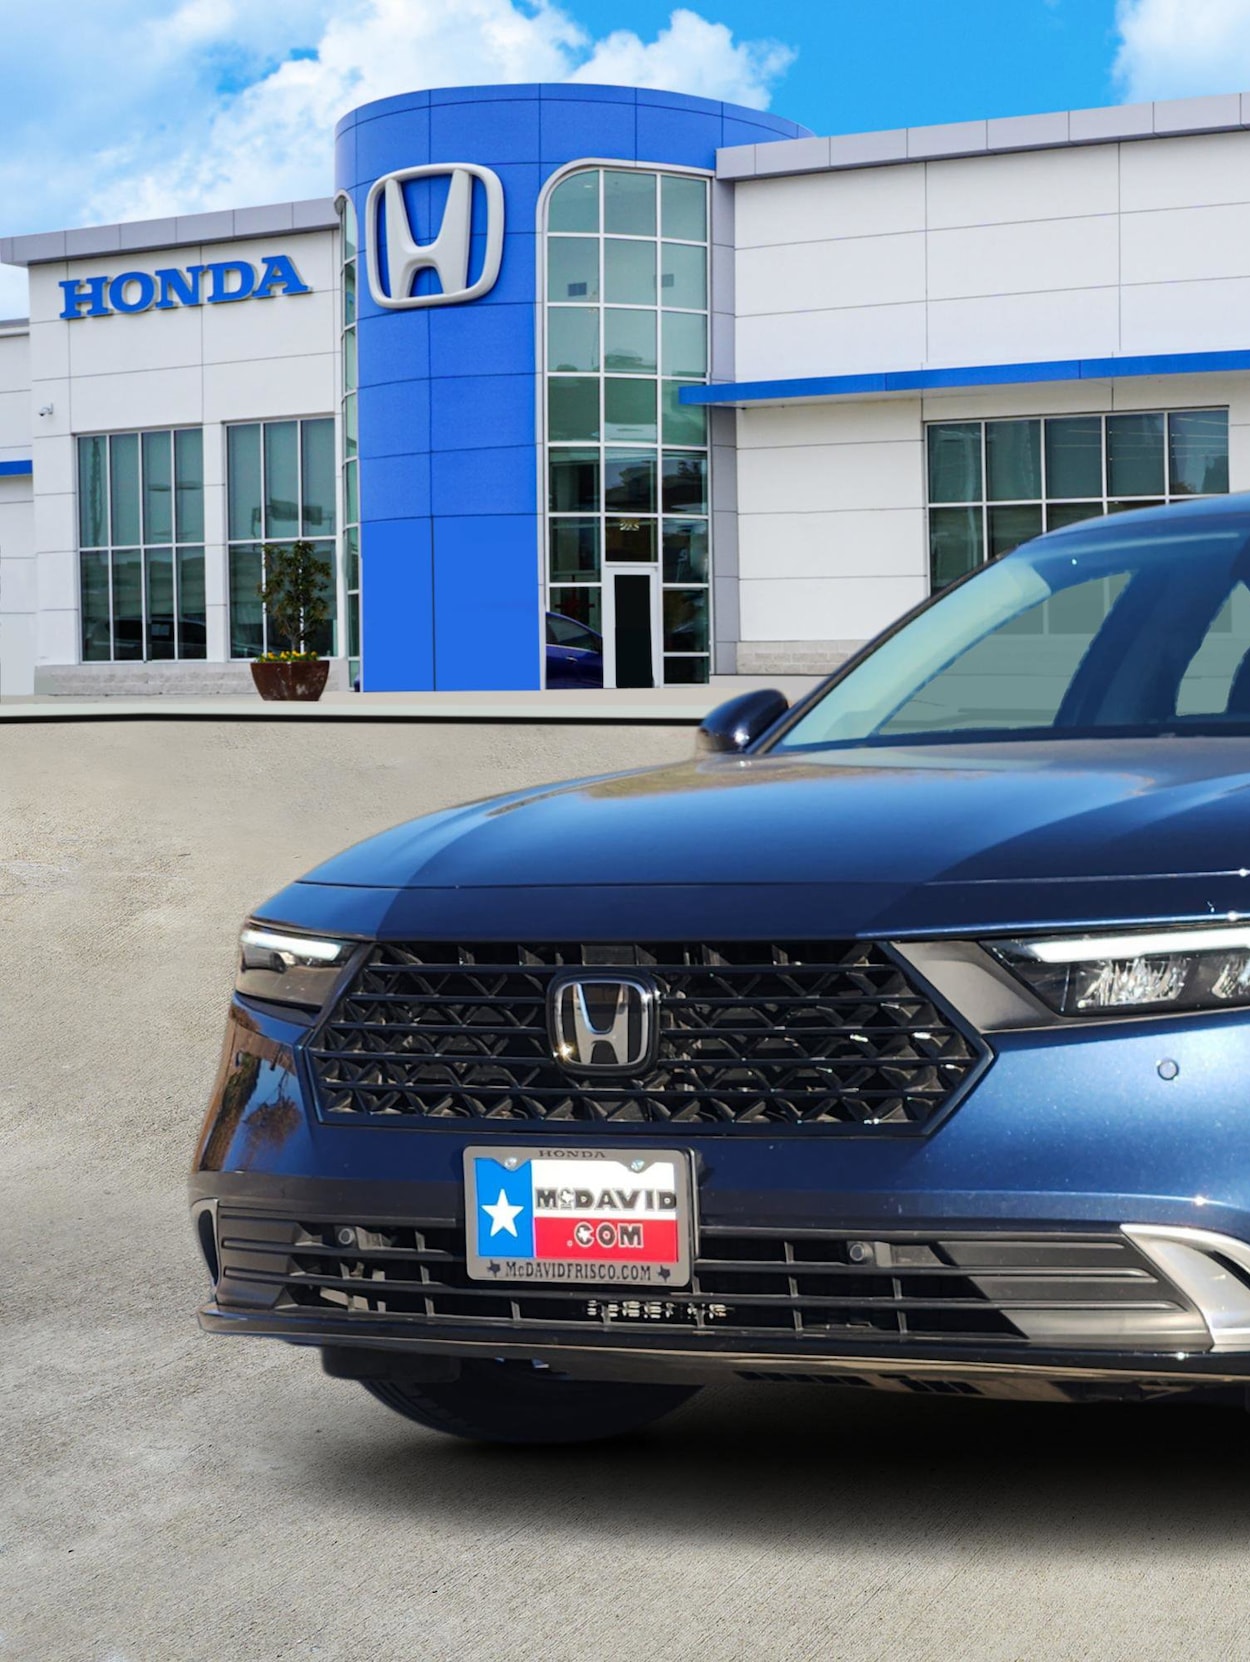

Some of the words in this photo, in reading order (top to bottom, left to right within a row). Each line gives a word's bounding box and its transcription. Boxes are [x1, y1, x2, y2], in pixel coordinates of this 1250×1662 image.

[58, 254, 311, 320] HONDA
[539, 1149, 606, 1159] HONDA
[505, 1261, 652, 1281] McDAVIDFRISCO.COM
